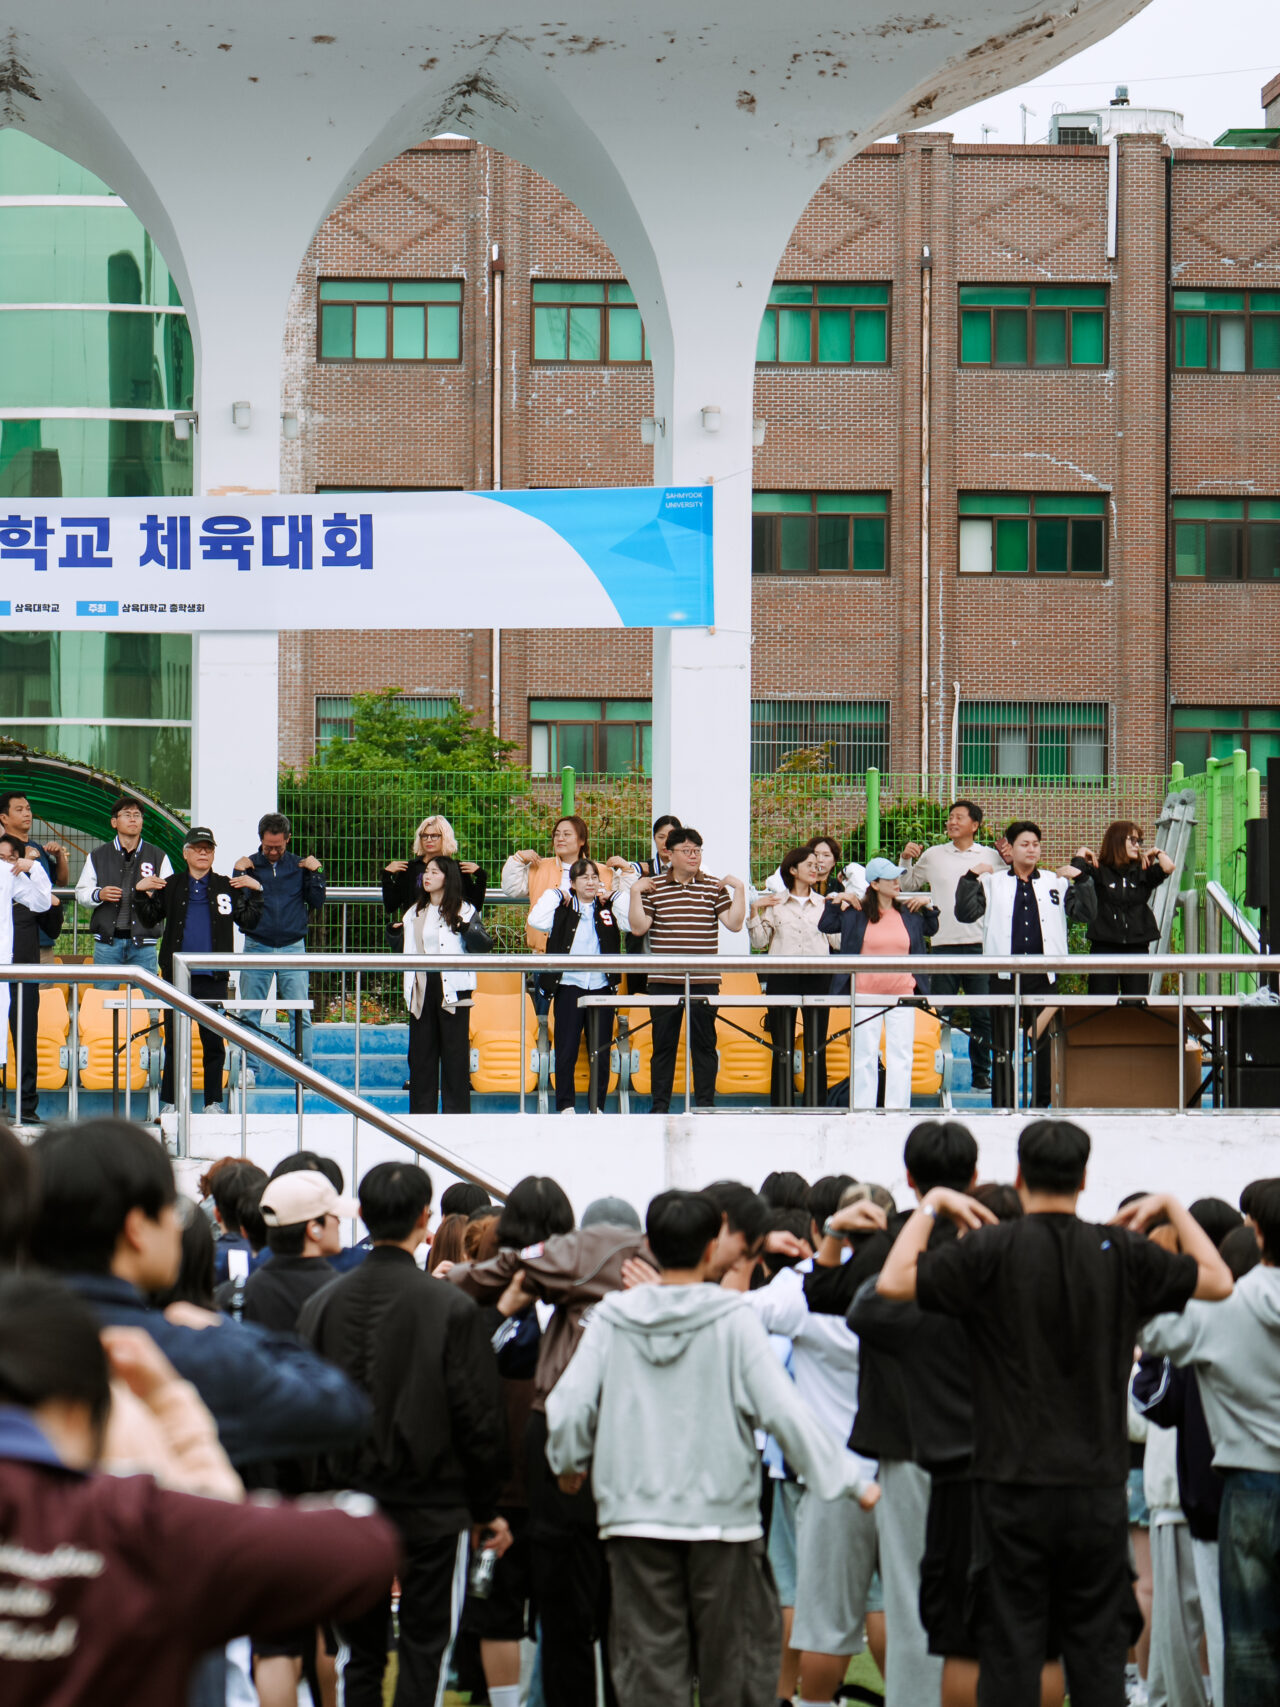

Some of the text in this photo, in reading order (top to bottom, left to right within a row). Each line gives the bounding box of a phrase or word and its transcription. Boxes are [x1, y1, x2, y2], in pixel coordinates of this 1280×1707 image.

[665, 501, 704, 509] UNIVERSITY
[139, 513, 373, 572] 체육대회
[15, 603, 60, 613] 삼육대학교
[121, 603, 167, 613] 삼육대학교
[169, 603, 205, 613] 총학생회
[141, 862, 154, 878] S
[217, 893, 233, 915] S
[1049, 888, 1060, 906] S
[600, 909, 613, 926] S
